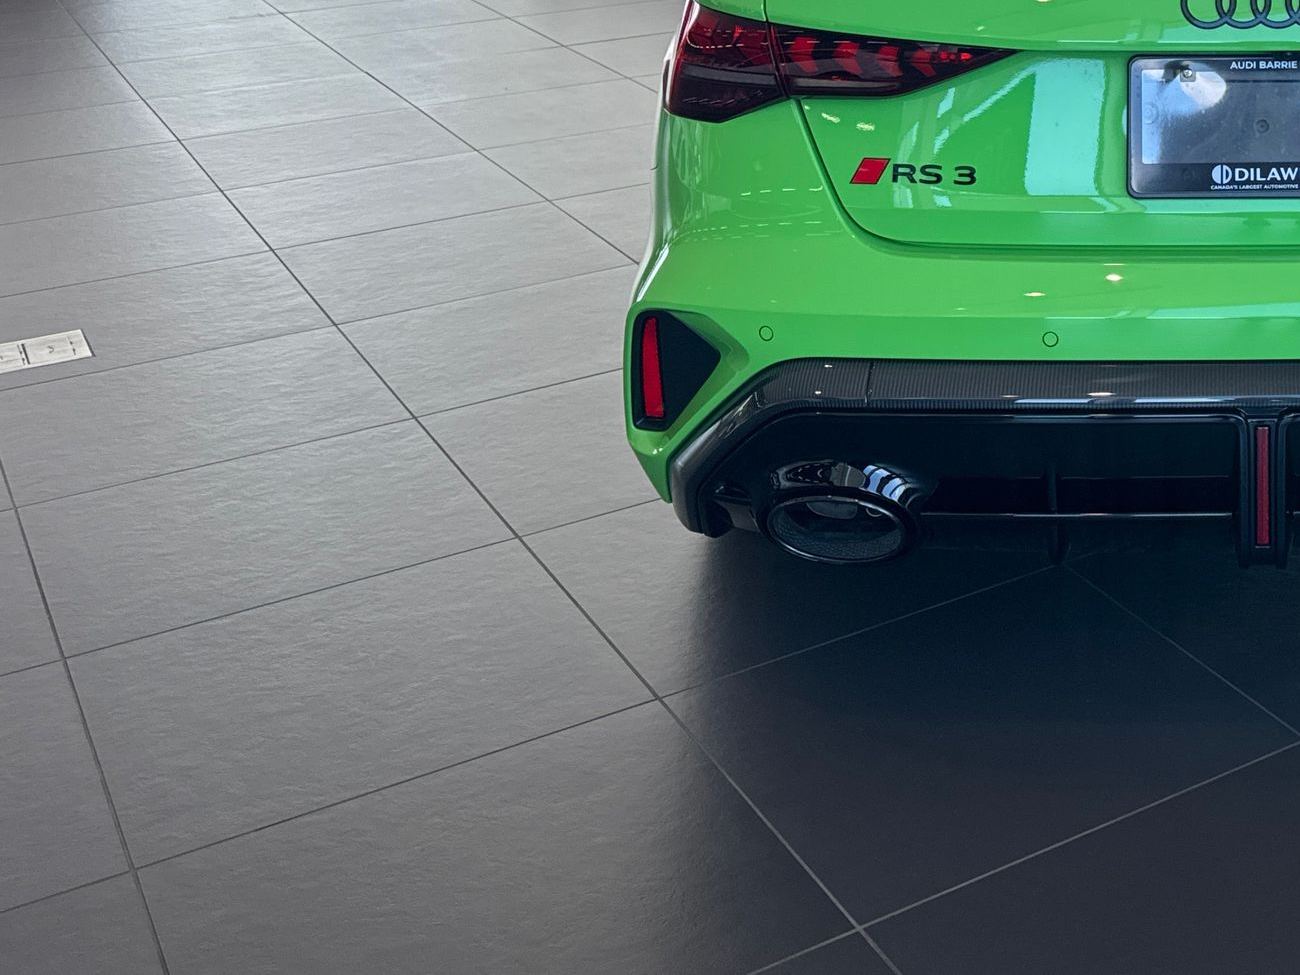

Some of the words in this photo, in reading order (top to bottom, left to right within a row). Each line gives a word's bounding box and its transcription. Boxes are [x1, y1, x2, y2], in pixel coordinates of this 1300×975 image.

[1229, 60, 1257, 70] AUDI
[1259, 60, 1298, 69] BARRIE
[891, 163, 943, 185] RS
[953, 165, 977, 185] 3
